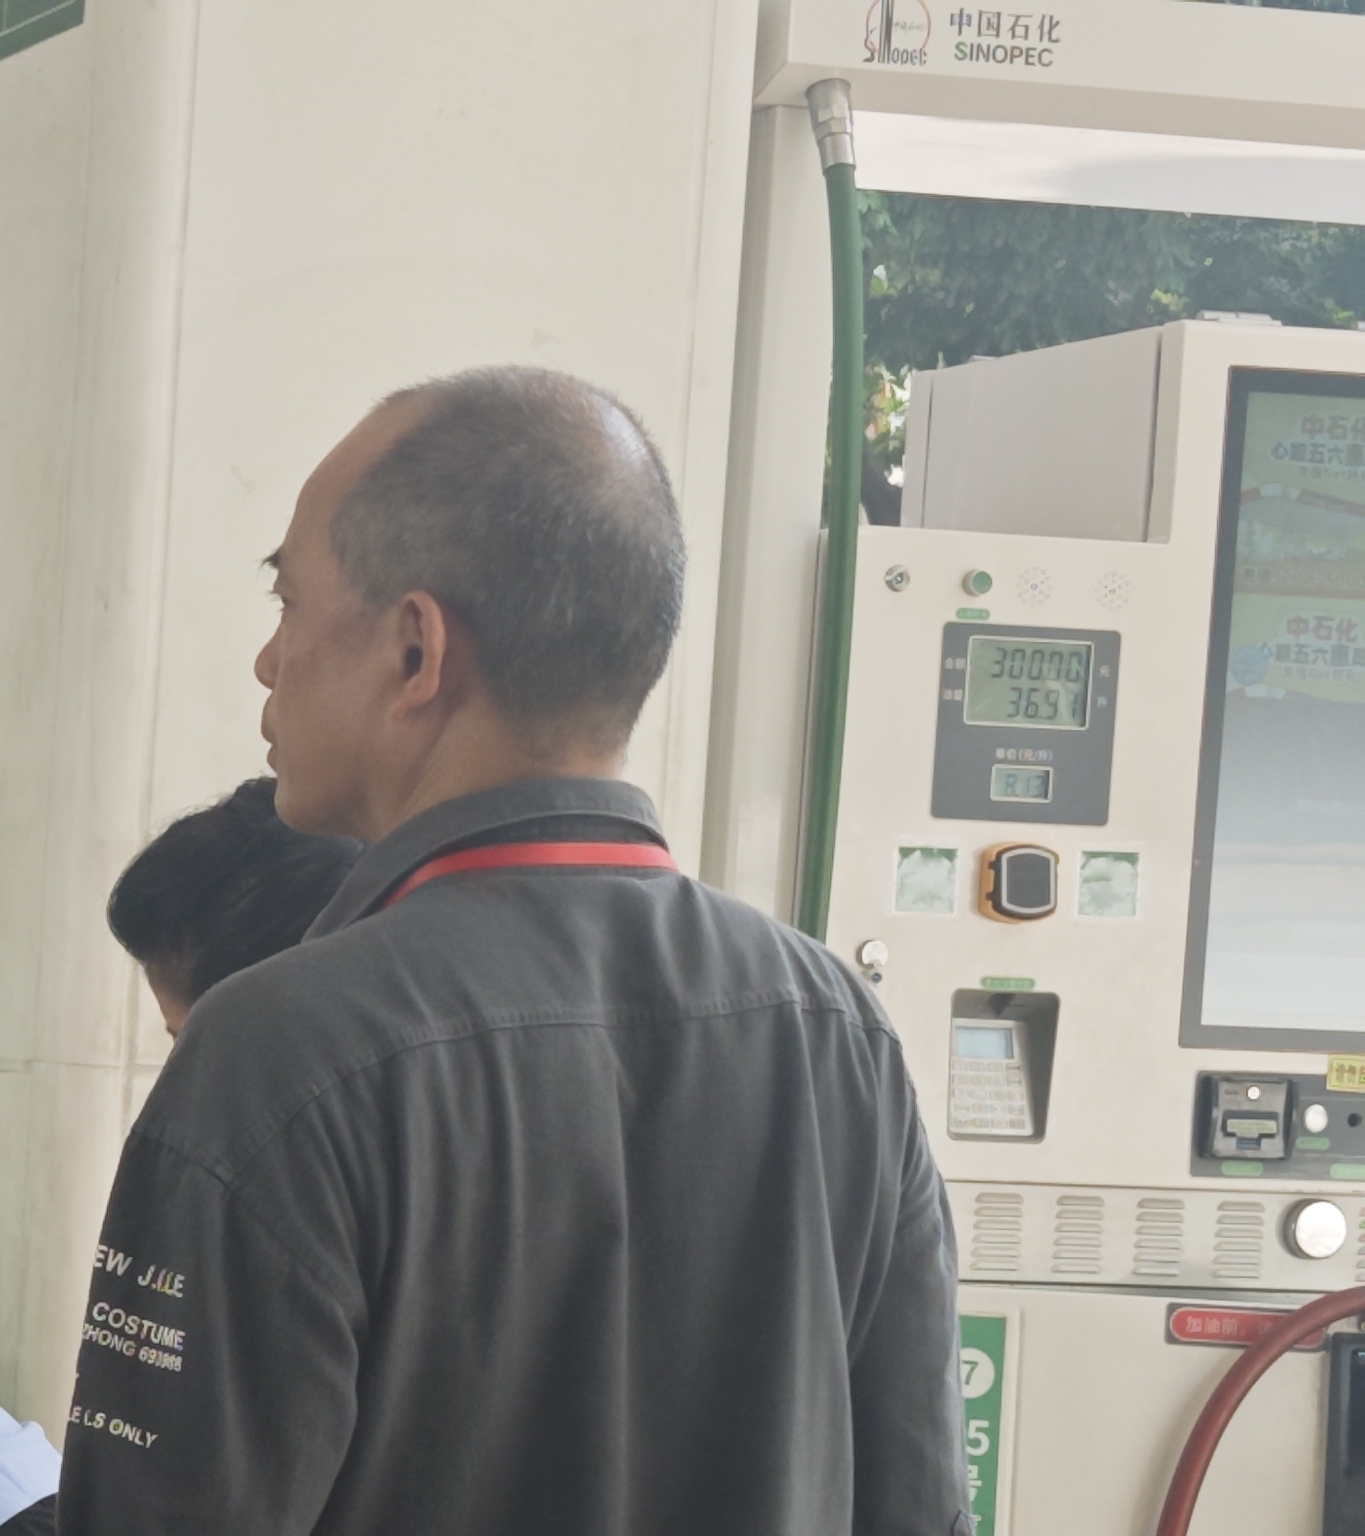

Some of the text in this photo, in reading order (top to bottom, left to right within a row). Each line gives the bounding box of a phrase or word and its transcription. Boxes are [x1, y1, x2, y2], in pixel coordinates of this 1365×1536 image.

[949, 8, 1061, 43] 中国石化
[954, 41, 1054, 67] SINOPEC
[92, 1302, 186, 1352] COSTUME
[962, 1360, 979, 1386] 7
[109, 1418, 159, 1449] ONLY
